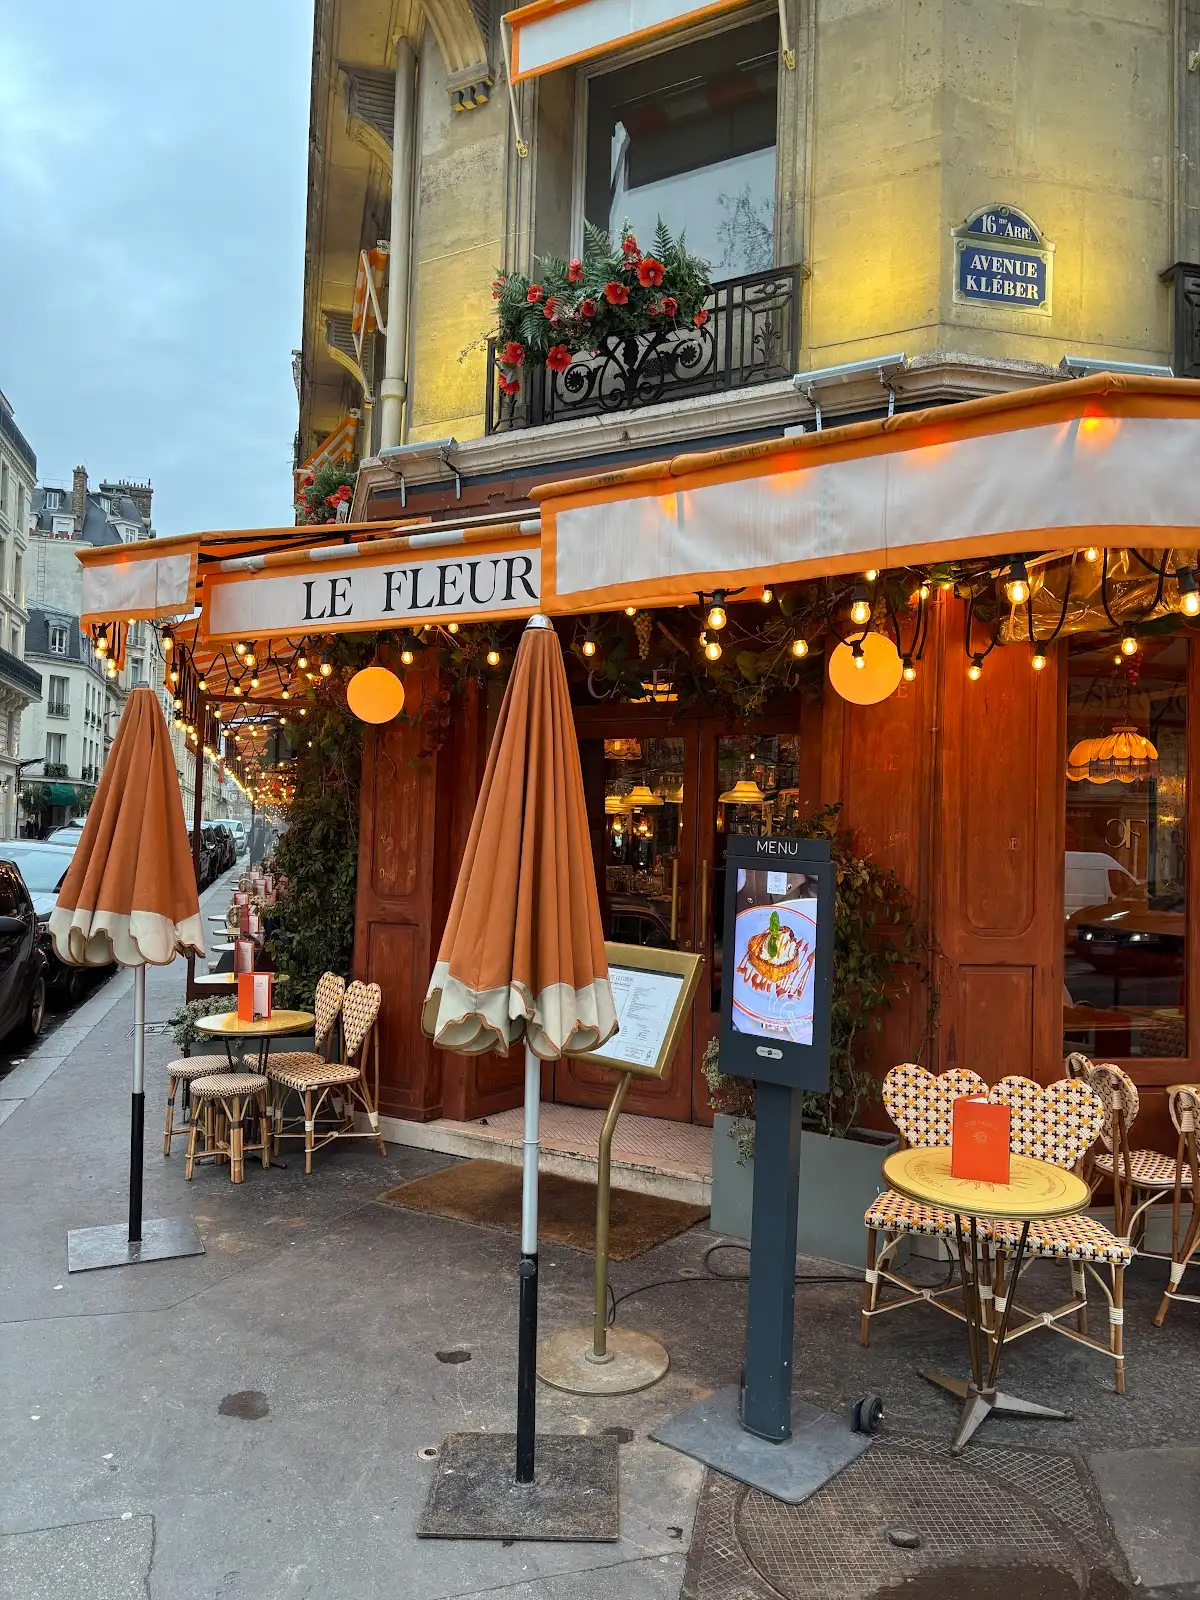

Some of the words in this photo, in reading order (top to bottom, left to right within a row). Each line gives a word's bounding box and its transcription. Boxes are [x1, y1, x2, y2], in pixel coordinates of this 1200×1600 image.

[970, 254, 1038, 279] AVENUE
[966, 274, 1039, 300] KLÉBER
[301, 576, 354, 621] LE
[382, 556, 540, 612] FLEUR
[757, 840, 798, 855] MENU
